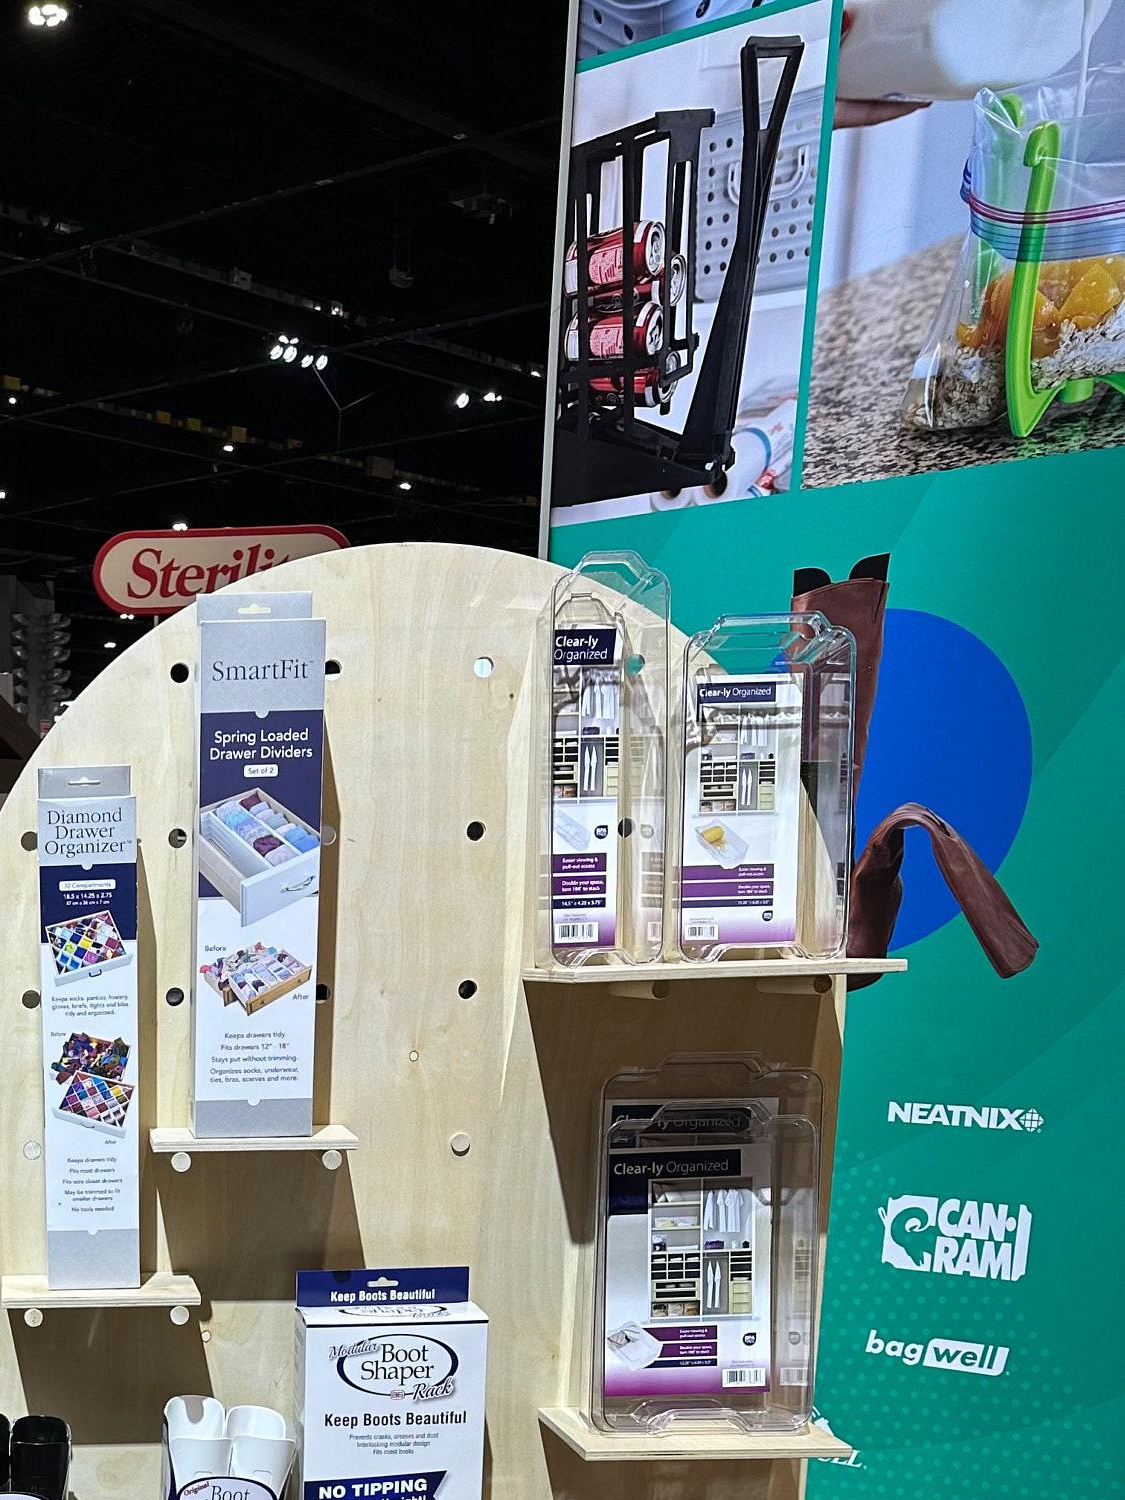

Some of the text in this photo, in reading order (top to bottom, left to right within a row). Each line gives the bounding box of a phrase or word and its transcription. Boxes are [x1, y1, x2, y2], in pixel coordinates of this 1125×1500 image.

[555, 635, 599, 650] Clear-ly
[554, 648, 608, 662] Organized
[699, 686, 771, 698] Clear-ly Organized
[215, 728, 308, 747] Spring Loaded
[210, 745, 313, 760] Drawer Dividers
[47, 807, 122, 824] Diamond
[56, 826, 115, 839] Drawer
[887, 1101, 1023, 1131] NEATNIX
[614, 1159, 729, 1175] Clear-ly Organized
[933, 1235, 1012, 1281] RAM
[330, 1289, 435, 1304] Keep Boots Beautiful
[381, 1343, 429, 1363] Boot
[361, 1361, 434, 1386] Shaper
[412, 1377, 453, 1401] Rack
[325, 1411, 467, 1429] Keep Boots Beautiful
[183, 1480, 210, 1497] Original
[319, 1478, 428, 1500] NO TIPPING
